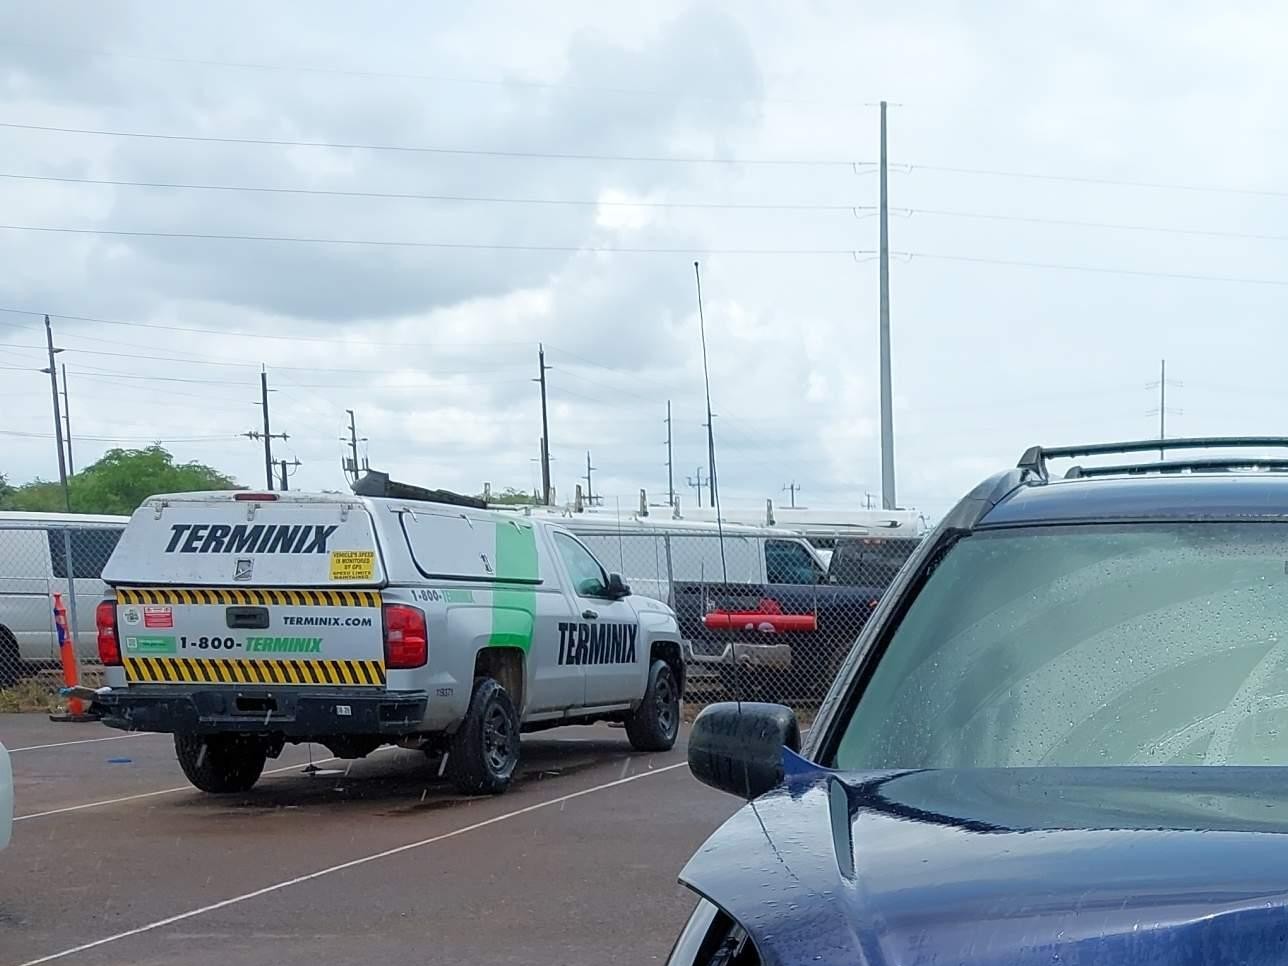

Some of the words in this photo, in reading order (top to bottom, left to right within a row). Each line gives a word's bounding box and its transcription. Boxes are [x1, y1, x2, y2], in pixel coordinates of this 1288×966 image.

[165, 525, 338, 553] TERMINIX
[283, 616, 372, 627] TERMINIX.COM
[558, 622, 638, 666] TERMINIX
